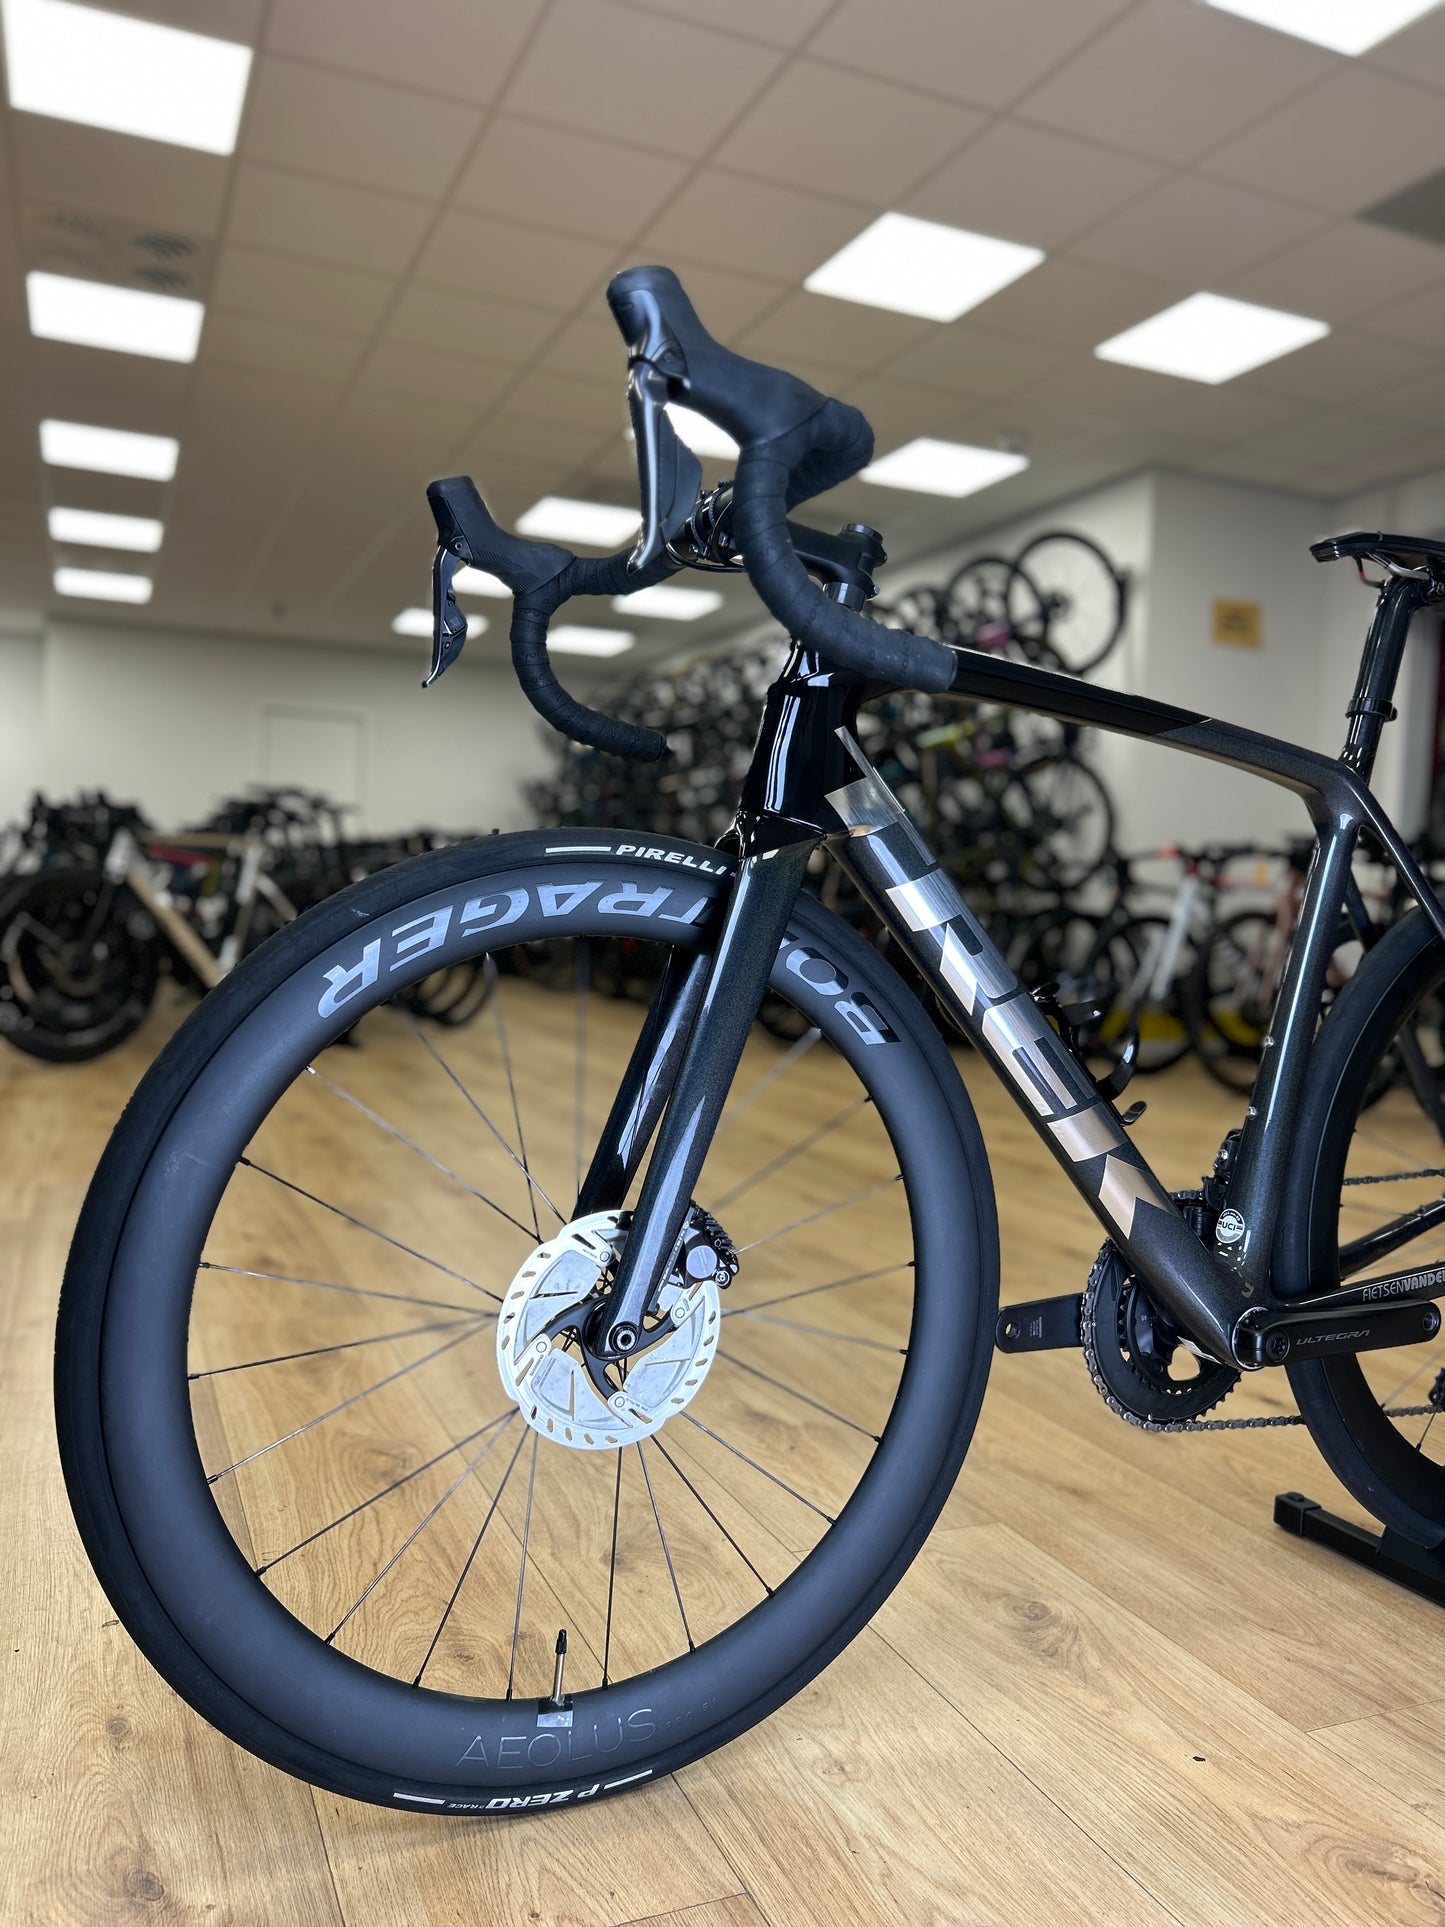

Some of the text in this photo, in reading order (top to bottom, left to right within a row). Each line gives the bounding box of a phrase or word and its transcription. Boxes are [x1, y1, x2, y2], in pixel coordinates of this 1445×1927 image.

[615, 844, 728, 876] PIRELLI
[824, 726, 1182, 1240] TREK
[1221, 1221, 1236, 1232] UCI
[1296, 1330, 1371, 1345] ULTEGRA
[454, 1708, 656, 1770] AEOLUS
[485, 1788, 574, 1809] ZERO
[577, 1783, 601, 1799] P
